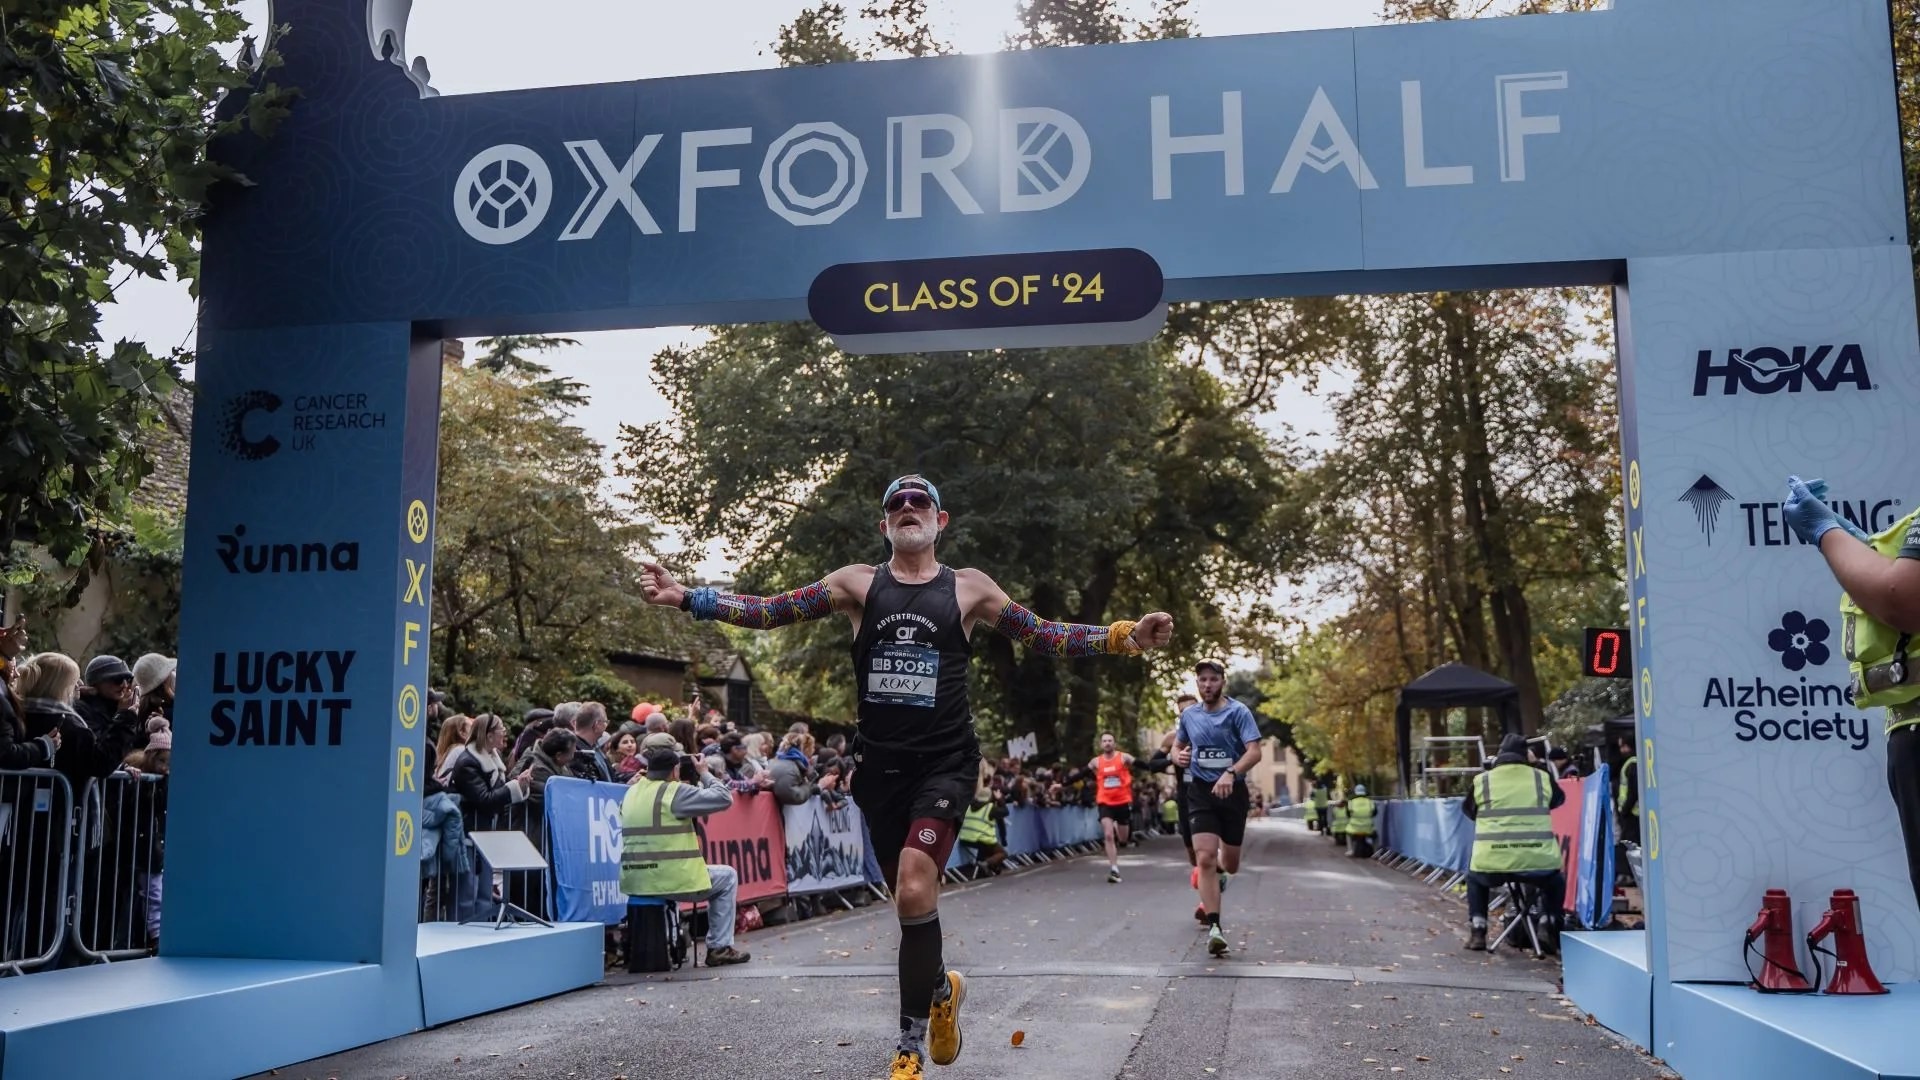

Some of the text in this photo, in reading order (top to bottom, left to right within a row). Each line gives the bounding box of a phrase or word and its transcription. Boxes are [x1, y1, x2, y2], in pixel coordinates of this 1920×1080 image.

[454, 71, 1569, 245] OXFORD HALF
[864, 280, 979, 313] CLASS
[989, 275, 1041, 308] OF
[1693, 344, 1872, 396] HOKA
[293, 412, 386, 431] RESEARCH
[294, 393, 368, 411] CANCER
[292, 434, 315, 451] UK
[216, 523, 359, 574] Runna
[876, 613, 938, 633] ADVENTRUNNING
[213, 651, 356, 694] LUCKY
[895, 659, 933, 675] 9025
[1594, 632, 1620, 674] 0
[1629, 459, 1660, 860] OXFORD
[395, 500, 428, 856] OXFORD
[879, 677, 922, 691] RORY
[1703, 676, 1857, 708] Alzheime
[209, 698, 352, 746] SAINT
[1734, 710, 1869, 750] Society
[588, 797, 622, 864] HO
